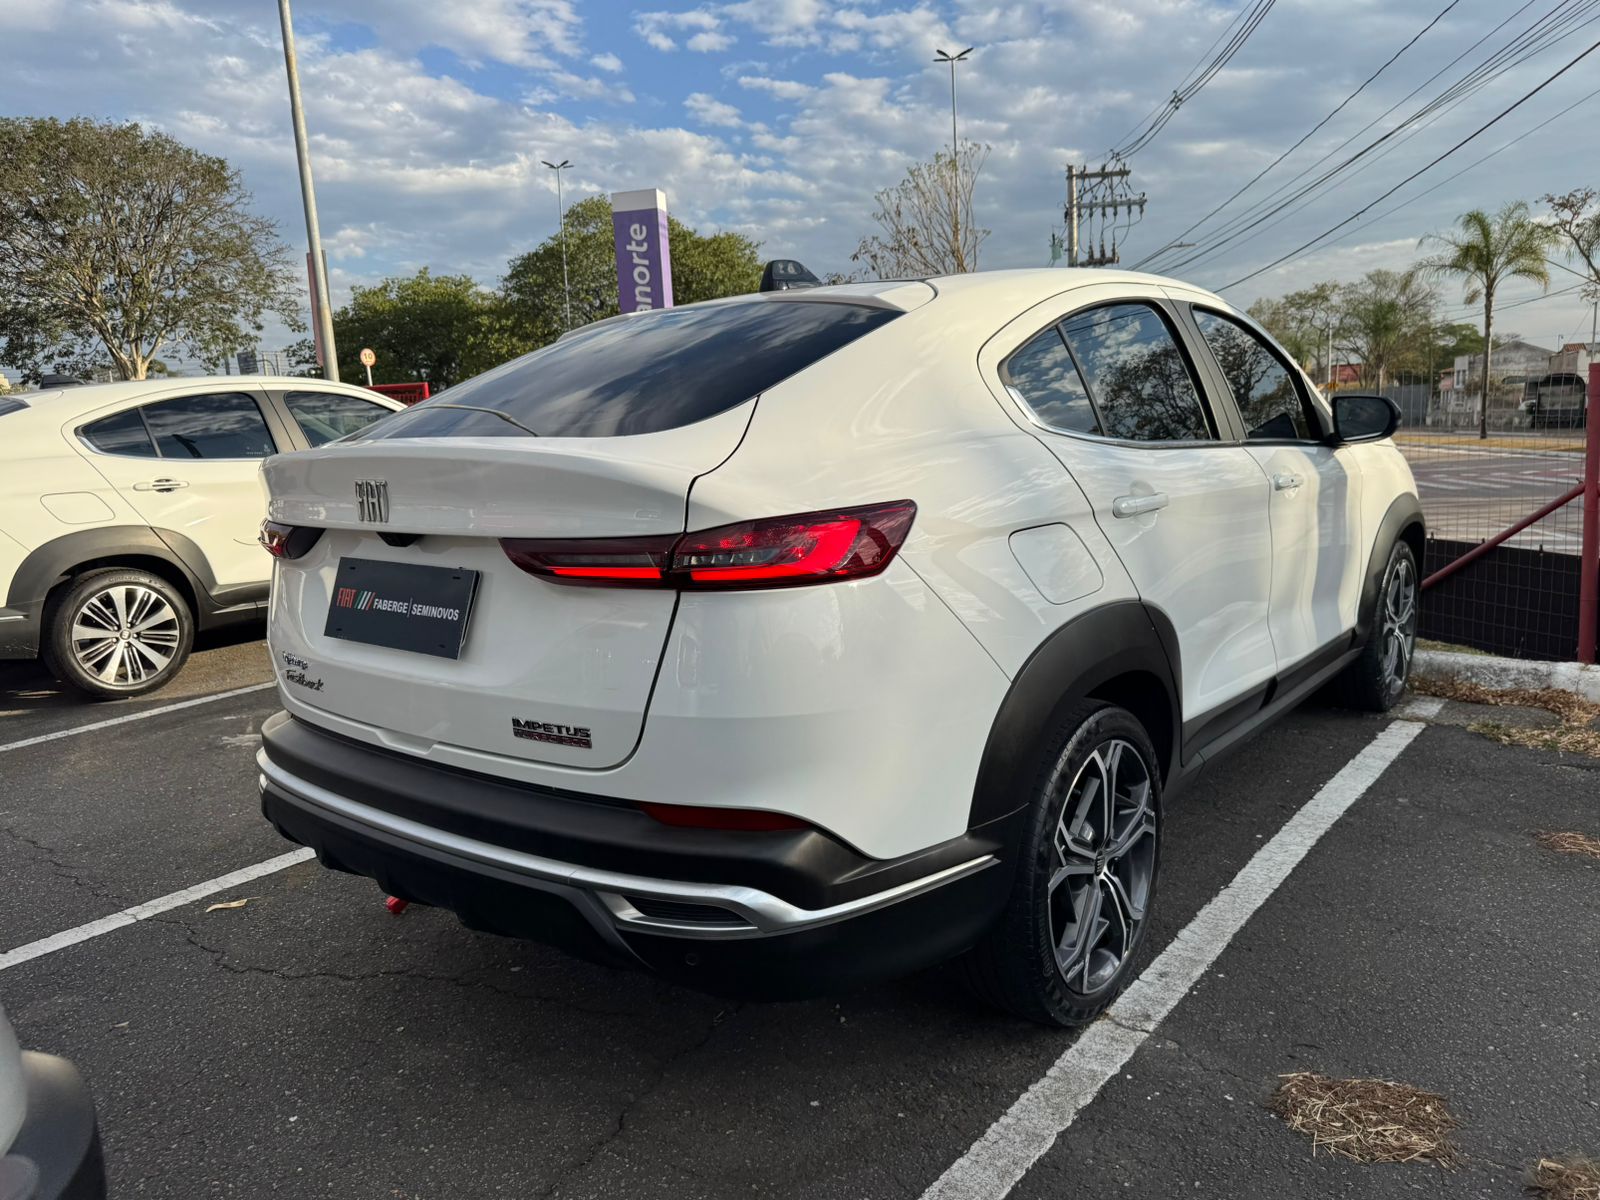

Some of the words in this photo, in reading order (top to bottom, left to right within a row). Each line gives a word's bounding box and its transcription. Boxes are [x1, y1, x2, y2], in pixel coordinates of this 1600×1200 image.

[355, 480, 390, 523] FIAT
[336, 587, 357, 608] FIAT
[373, 598, 408, 613] FABERGE
[411, 603, 460, 621] SEMINOVOS
[511, 717, 592, 738] IMPETUS
